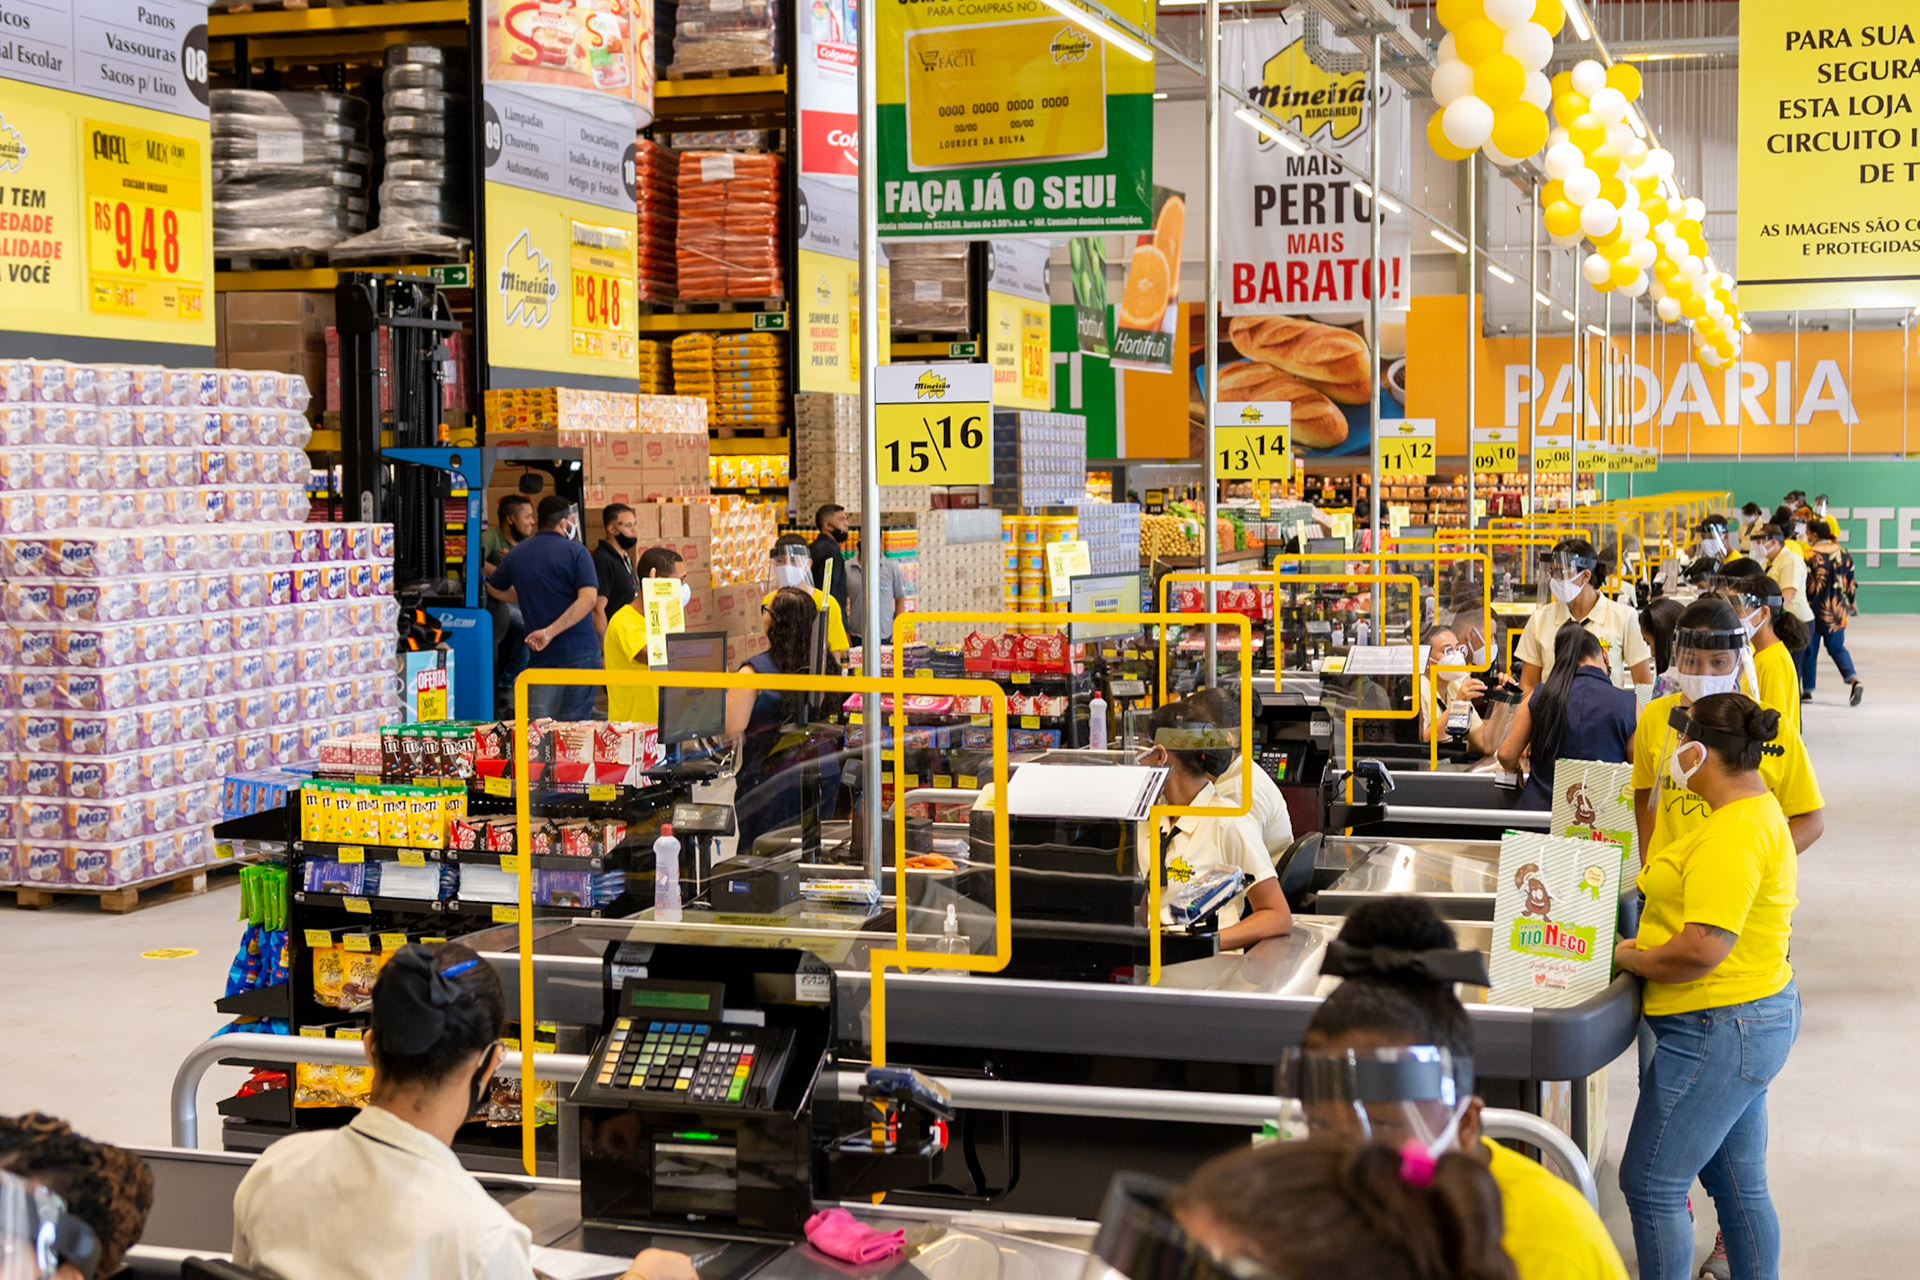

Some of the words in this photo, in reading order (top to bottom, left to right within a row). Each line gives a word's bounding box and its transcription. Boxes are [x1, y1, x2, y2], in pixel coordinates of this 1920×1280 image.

[138, 6, 175, 30] Panos
[927, 6, 954, 17] PARA
[958, 2, 1014, 15] COMPRAS
[1017, 1, 1037, 12] NO
[106, 32, 177, 63] Vassouras
[1785, 27, 1853, 51] PARA
[1861, 24, 1916, 48] SUA
[18, 45, 62, 71] Escolar
[185, 46, 207, 84] 08
[819, 47, 855, 64] Colgate
[101, 64, 134, 87] Sacos
[139, 76, 150, 94] p/
[153, 77, 176, 96] Lixo
[505, 106, 543, 128] Lâmpadas
[939, 105, 965, 118] 0000
[972, 102, 999, 114] 0000
[1007, 99, 1034, 112] 0000
[1042, 96, 1069, 109] 0000
[1305, 107, 1358, 119] ATACAREJO
[1779, 97, 1840, 121] ESTA
[1849, 93, 1913, 121] LOJA
[485, 121, 501, 150] 09
[505, 133, 539, 153] Chuveiro
[580, 128, 619, 150] Descartáveis
[939, 138, 978, 150] LOURDES
[983, 136, 994, 146] DA
[999, 134, 1026, 145] SILVA
[1766, 127, 1901, 154] CIRCUITO
[506, 160, 549, 181] Automotivo
[569, 151, 590, 167] Toalha
[592, 157, 600, 169] de
[602, 160, 619, 176] papel
[624, 160, 636, 185] 10
[1287, 154, 1343, 177] MAIS
[1860, 163, 1895, 185] DE
[568, 175, 589, 193] Artigo
[11, 187, 46, 208] TEM
[884, 178, 965, 219] FAÇA
[970, 172, 1007, 211] JÁ
[1013, 176, 1035, 210] O
[1042, 174, 1117, 209] SEU!
[94, 202, 111, 234] R$
[115, 202, 179, 273] 9,48
[1759, 223, 1780, 238] AS
[1785, 219, 1861, 237] IMAGENS
[1865, 217, 1900, 235] SÃO
[1288, 232, 1344, 254] MAIS
[1802, 244, 1812, 257] E
[9, 260, 51, 283] VOCÊ
[1233, 257, 1400, 304] BARATO!
[501, 272, 556, 296] Mineirão
[587, 276, 620, 327] 8,48
[1115, 332, 1166, 358] Hortifruti
[1504, 359, 1860, 428] PADARIA
[885, 440, 929, 472] 15
[936, 416, 983, 449] 16
[1219, 450, 1249, 470] 13
[1256, 435, 1285, 456] 14
[1382, 454, 1401, 469] 11
[1410, 443, 1432, 458] 12
[1475, 456, 1494, 469] 09
[1498, 447, 1516, 460] 10
[1536, 459, 1551, 470] 07
[1554, 451, 1570, 462] 08
[62, 547, 92, 561] Max
[272, 577, 290, 593] Max
[302, 575, 318, 590] Max
[330, 572, 345, 587] Max
[66, 592, 95, 607] Max
[69, 637, 98, 651] Max
[69, 680, 97, 696] Max
[418, 669, 446, 690] OFERTA
[27, 722, 57, 739] Max
[73, 725, 102, 740] Max
[28, 767, 57, 782] Max
[72, 770, 100, 785] Max
[77, 811, 108, 827] Max
[30, 853, 59, 868] Max
[76, 854, 106, 870] Max
[1520, 930, 1542, 946] TIO
